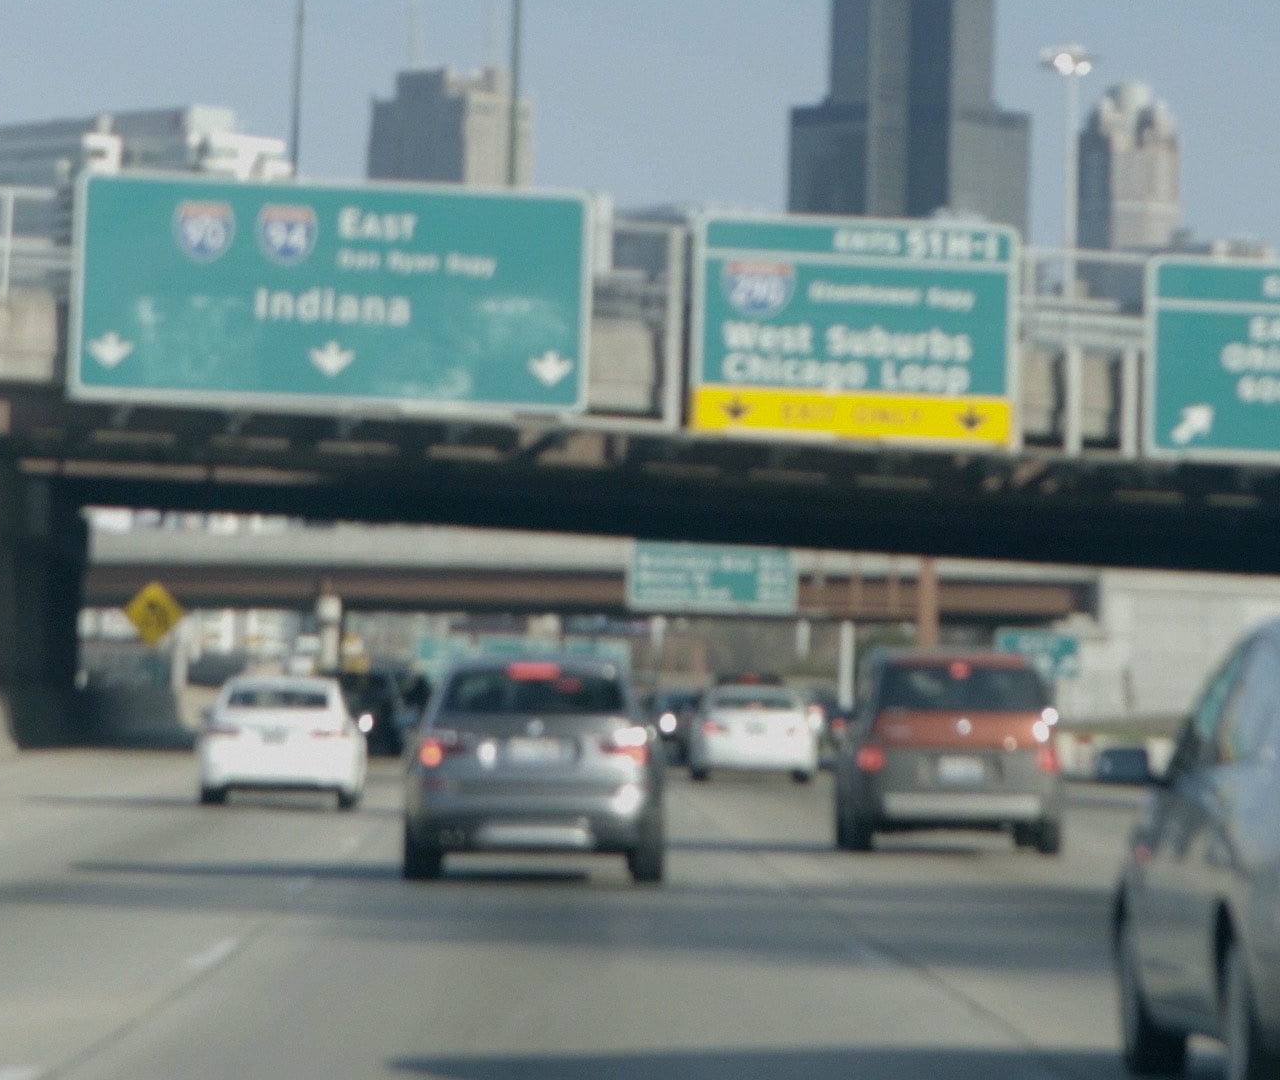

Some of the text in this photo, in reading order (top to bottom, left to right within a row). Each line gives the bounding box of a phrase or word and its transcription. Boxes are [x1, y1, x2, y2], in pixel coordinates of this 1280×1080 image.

[188, 207, 418, 251] 90 94 EAST
[337, 247, 496, 280] Dan Ryan Expy
[255, 288, 411, 328] Indiana
[729, 275, 786, 306] 290
[723, 320, 972, 362] West Suburbs
[723, 352, 970, 398] Chicago Loop
